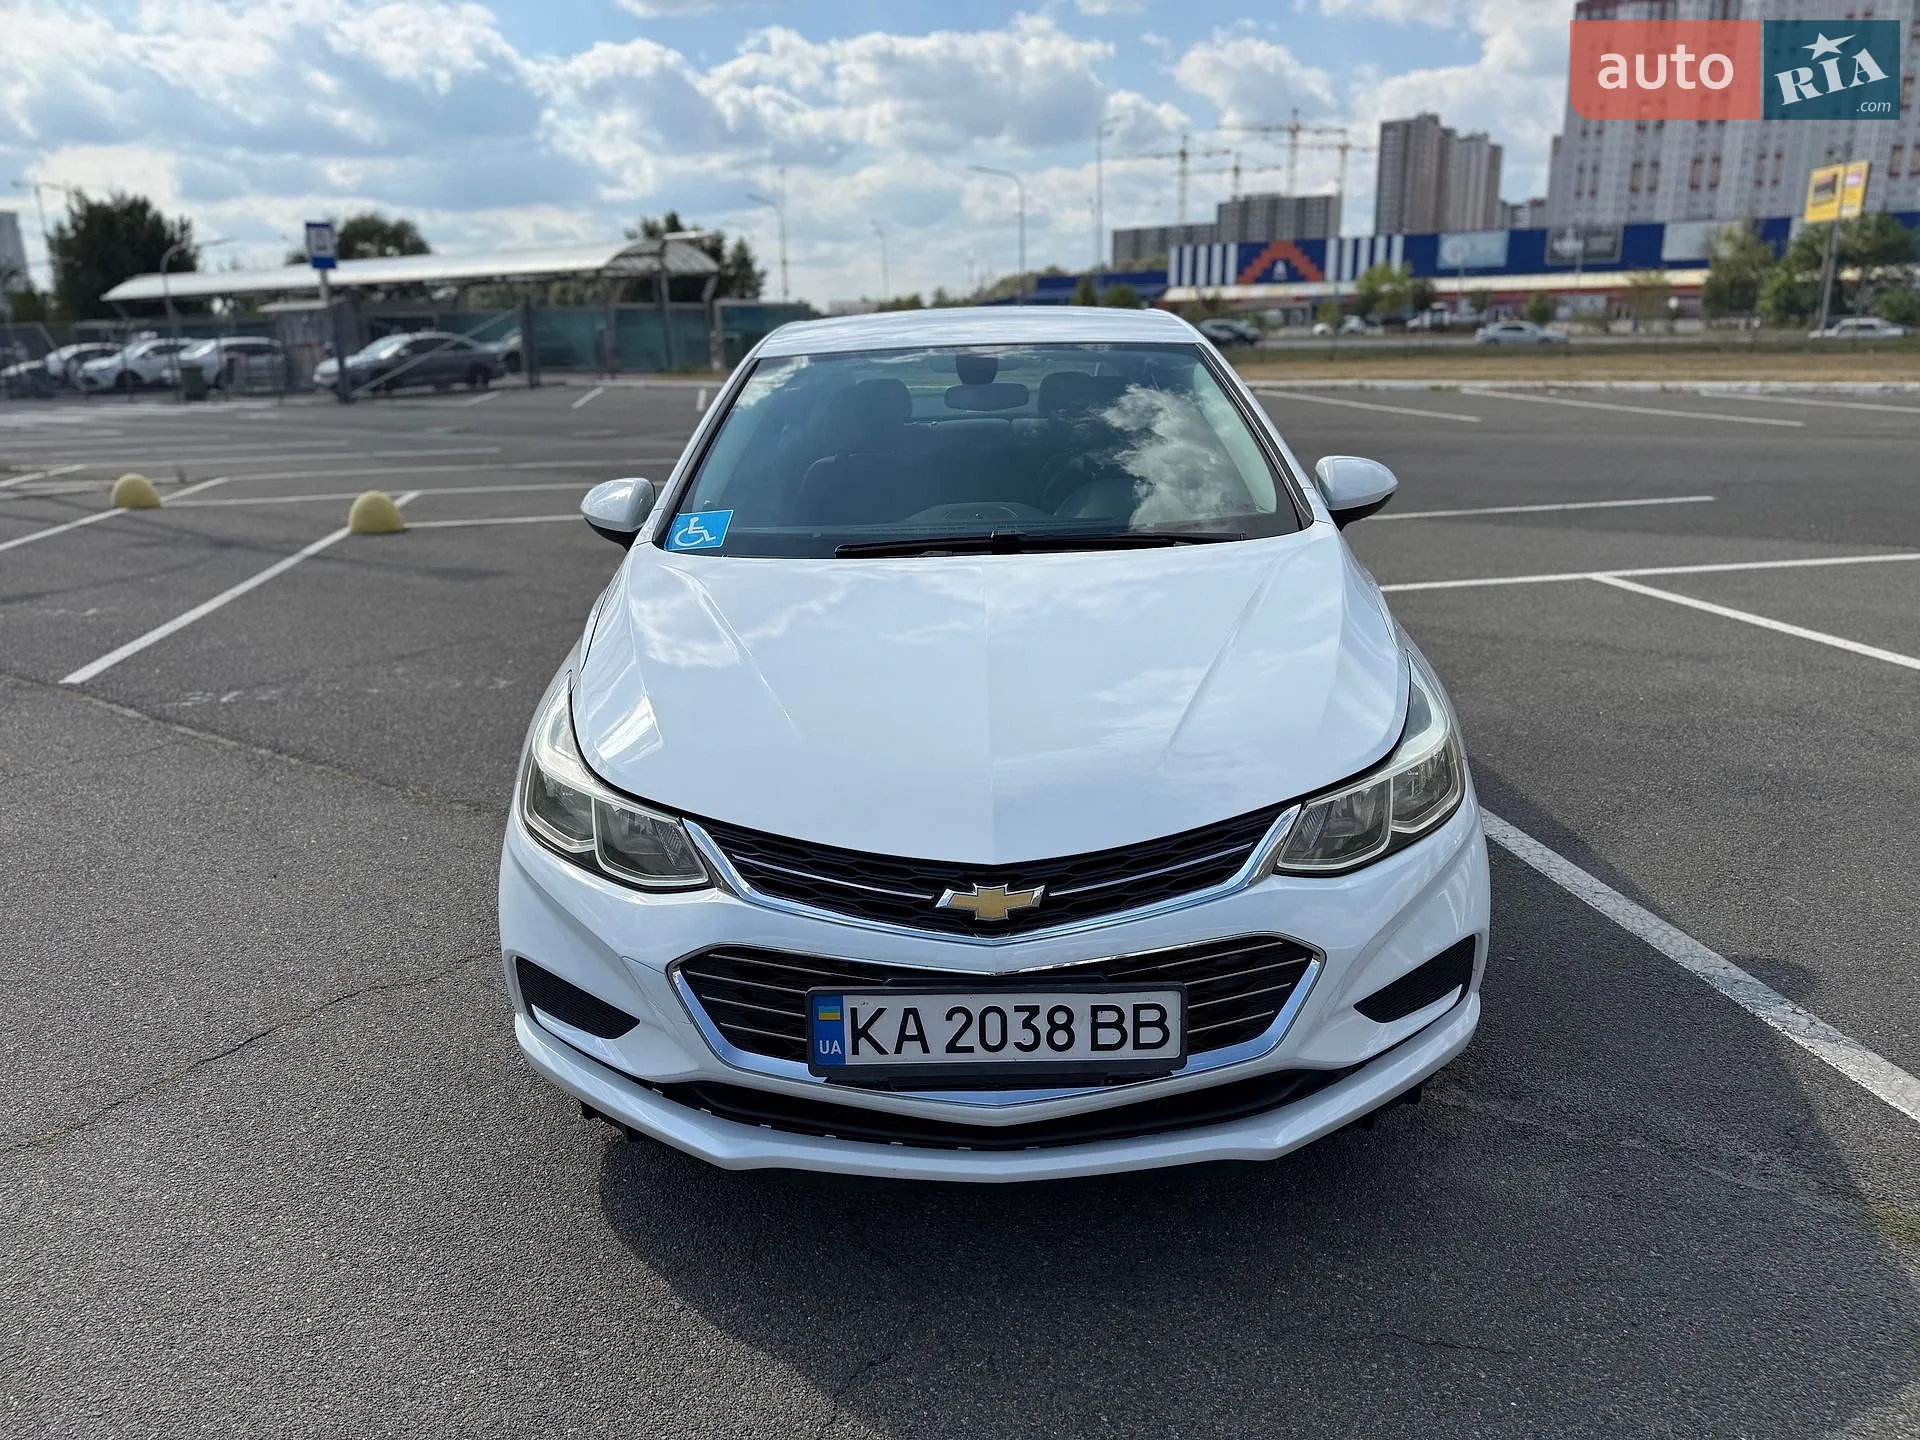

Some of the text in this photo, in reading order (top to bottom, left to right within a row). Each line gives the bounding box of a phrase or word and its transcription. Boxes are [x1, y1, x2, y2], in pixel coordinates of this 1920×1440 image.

[850, 1002, 1171, 1056] KA 2038 BB
[819, 1040, 842, 1055] UA
